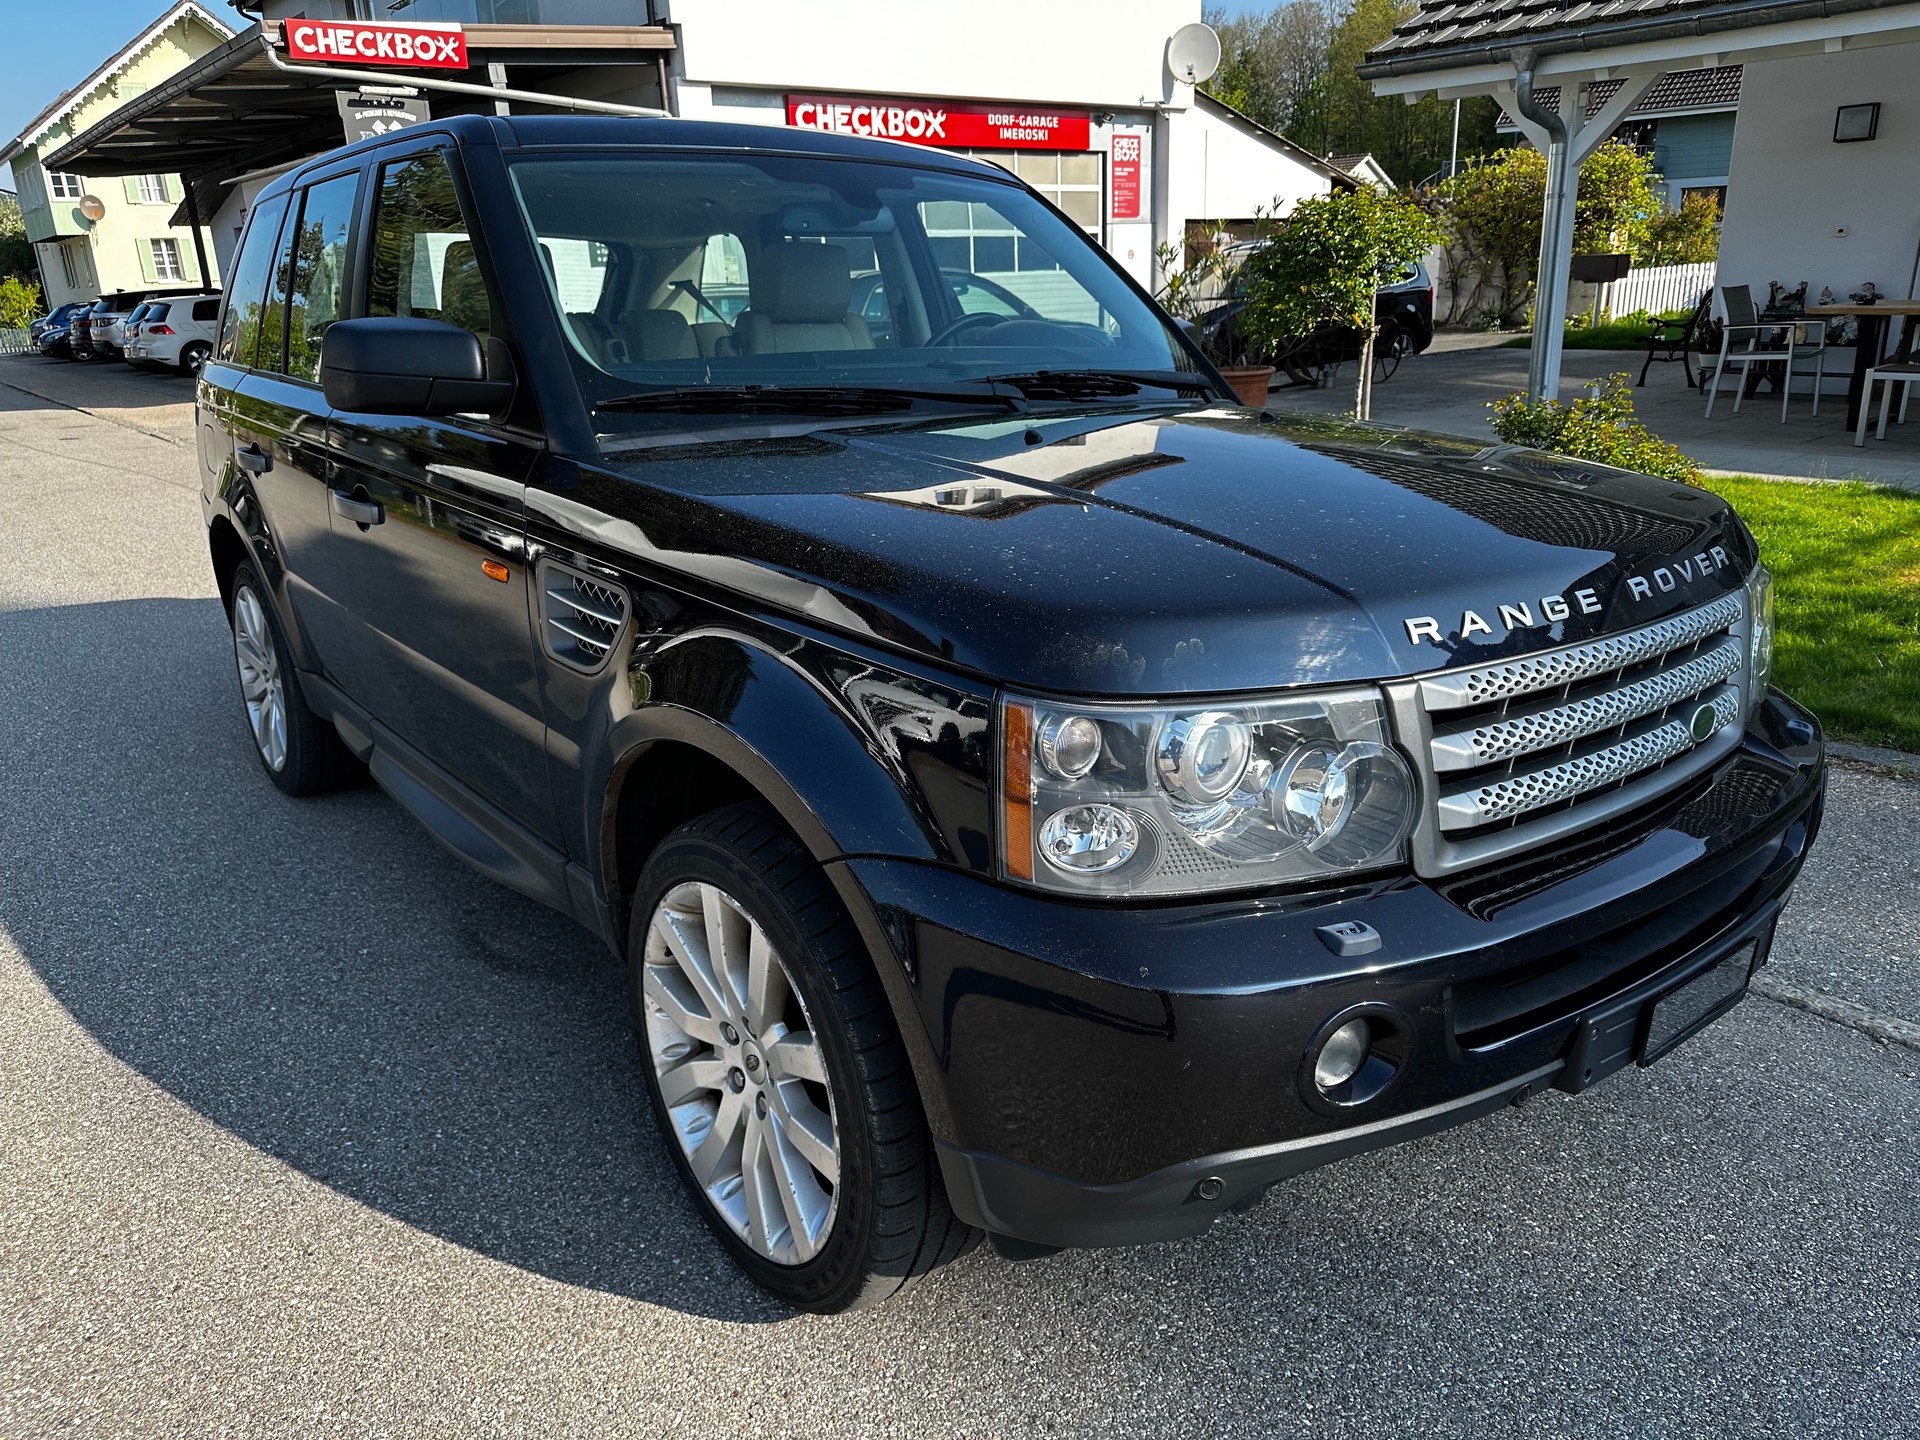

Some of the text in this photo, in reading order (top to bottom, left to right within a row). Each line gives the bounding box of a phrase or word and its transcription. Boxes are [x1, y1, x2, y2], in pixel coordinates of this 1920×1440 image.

[294, 26, 460, 63] CHECKBOX
[795, 102, 947, 139] CHECKBOX
[999, 127, 1048, 141] IMEROSKI
[1114, 138, 1139, 148] CHECK
[1114, 147, 1139, 162] BOX
[1403, 545, 1731, 646] RANGE ROVER
